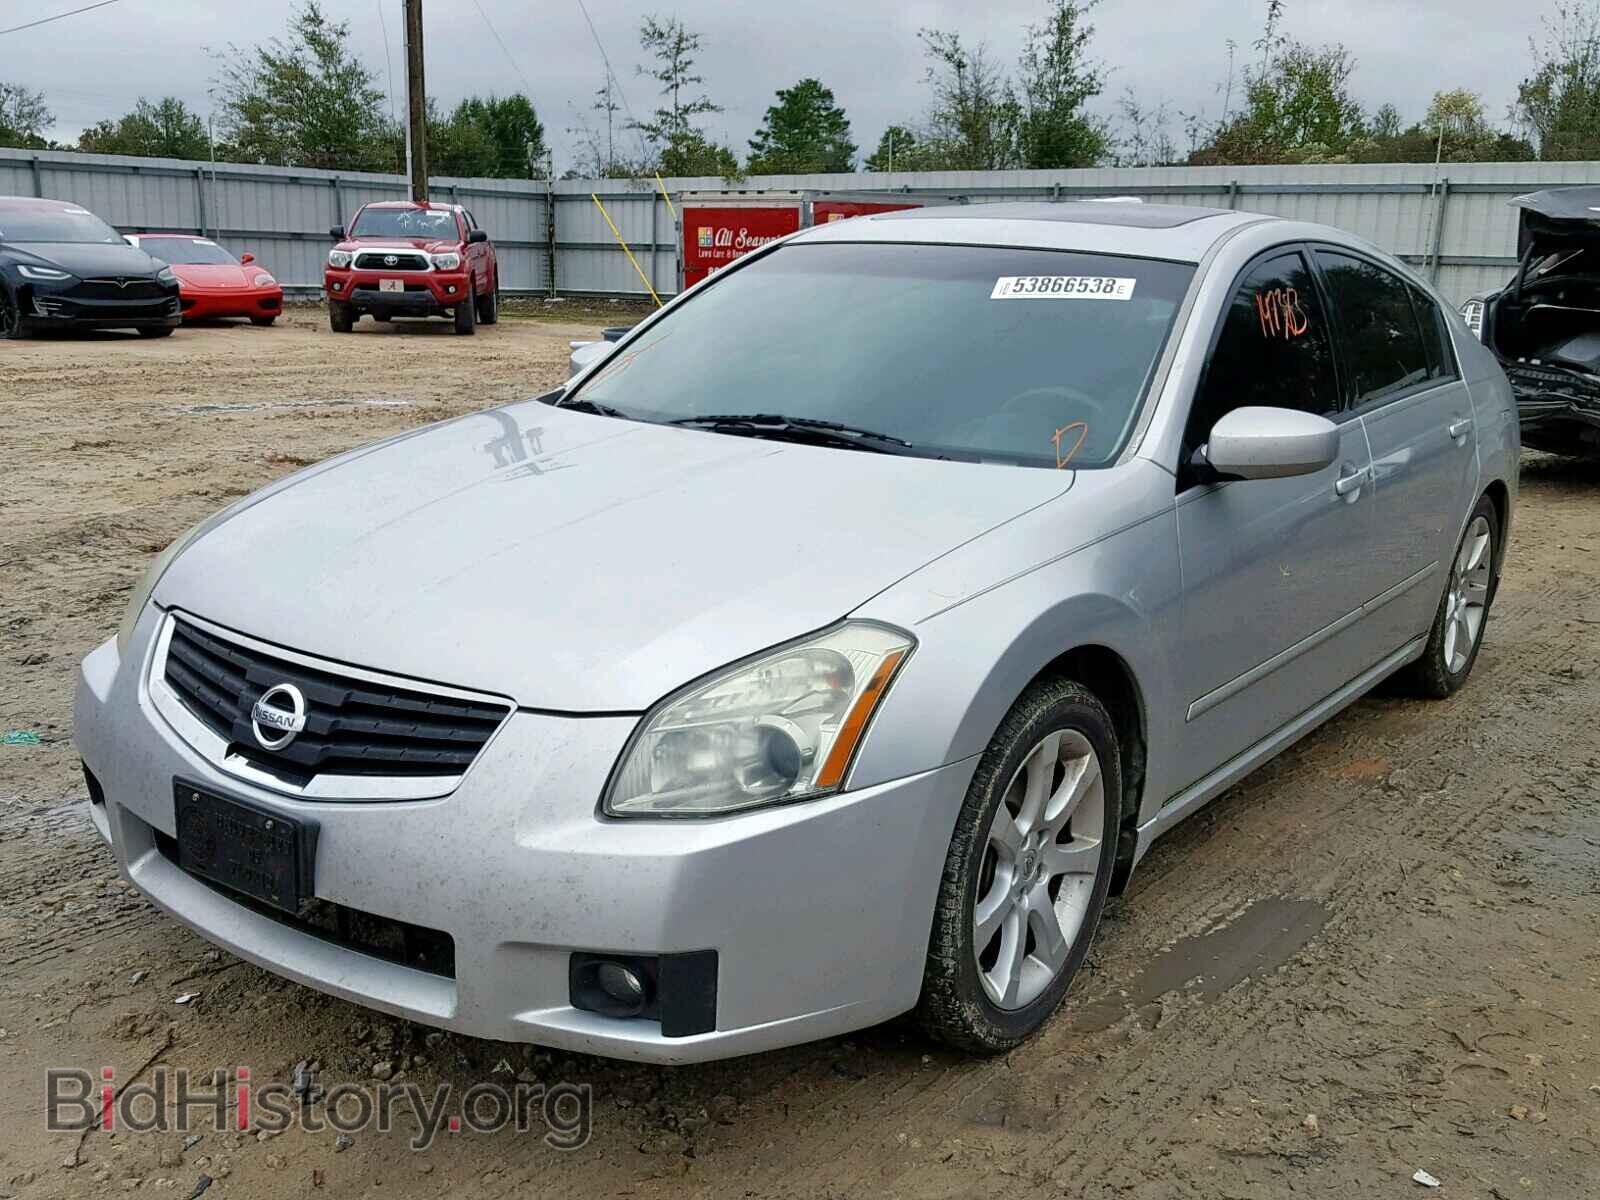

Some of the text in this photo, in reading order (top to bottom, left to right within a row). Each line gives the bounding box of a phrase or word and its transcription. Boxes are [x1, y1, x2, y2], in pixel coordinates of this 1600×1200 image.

[715, 227, 733, 246] All
[1012, 277, 1116, 294] 53866538
[254, 704, 296, 727] NISSAN
